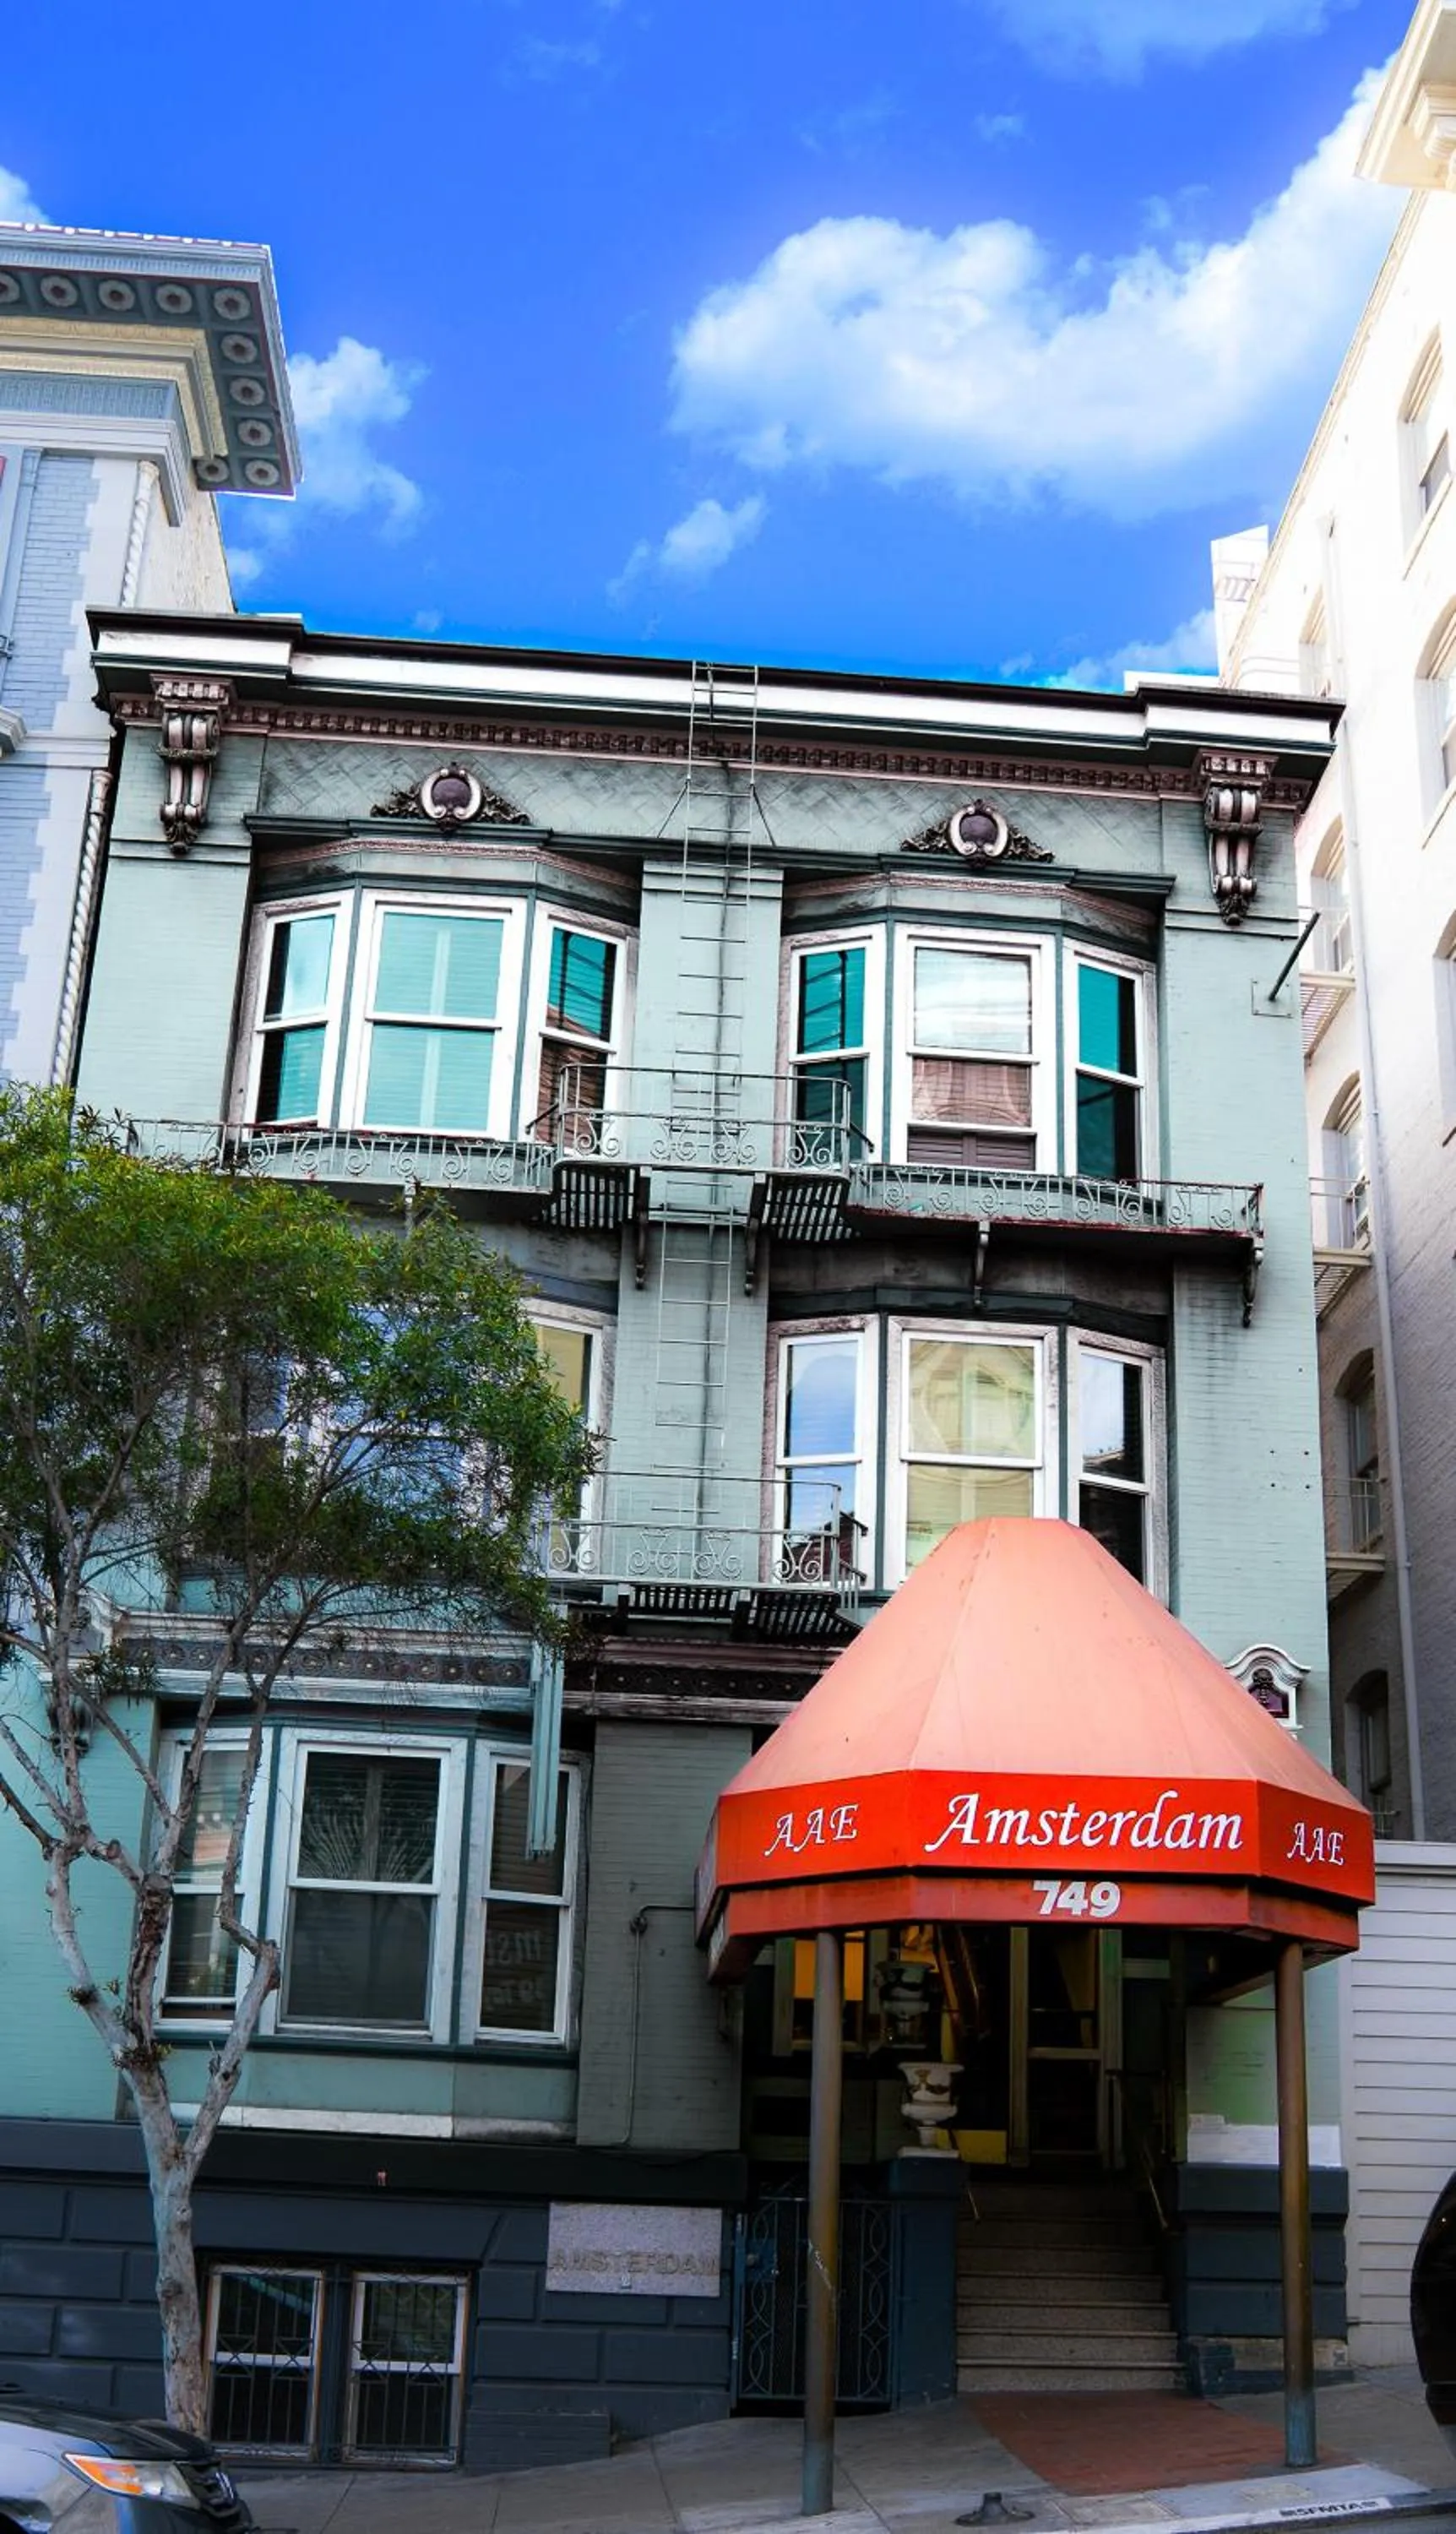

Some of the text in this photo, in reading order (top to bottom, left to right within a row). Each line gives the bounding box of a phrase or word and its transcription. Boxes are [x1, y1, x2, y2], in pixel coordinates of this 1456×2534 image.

[763, 1803, 859, 1857] AAE
[924, 1790, 1243, 1852] Amsterdam
[1286, 1822, 1344, 1866] AAE
[1033, 1880, 1121, 1917] 749
